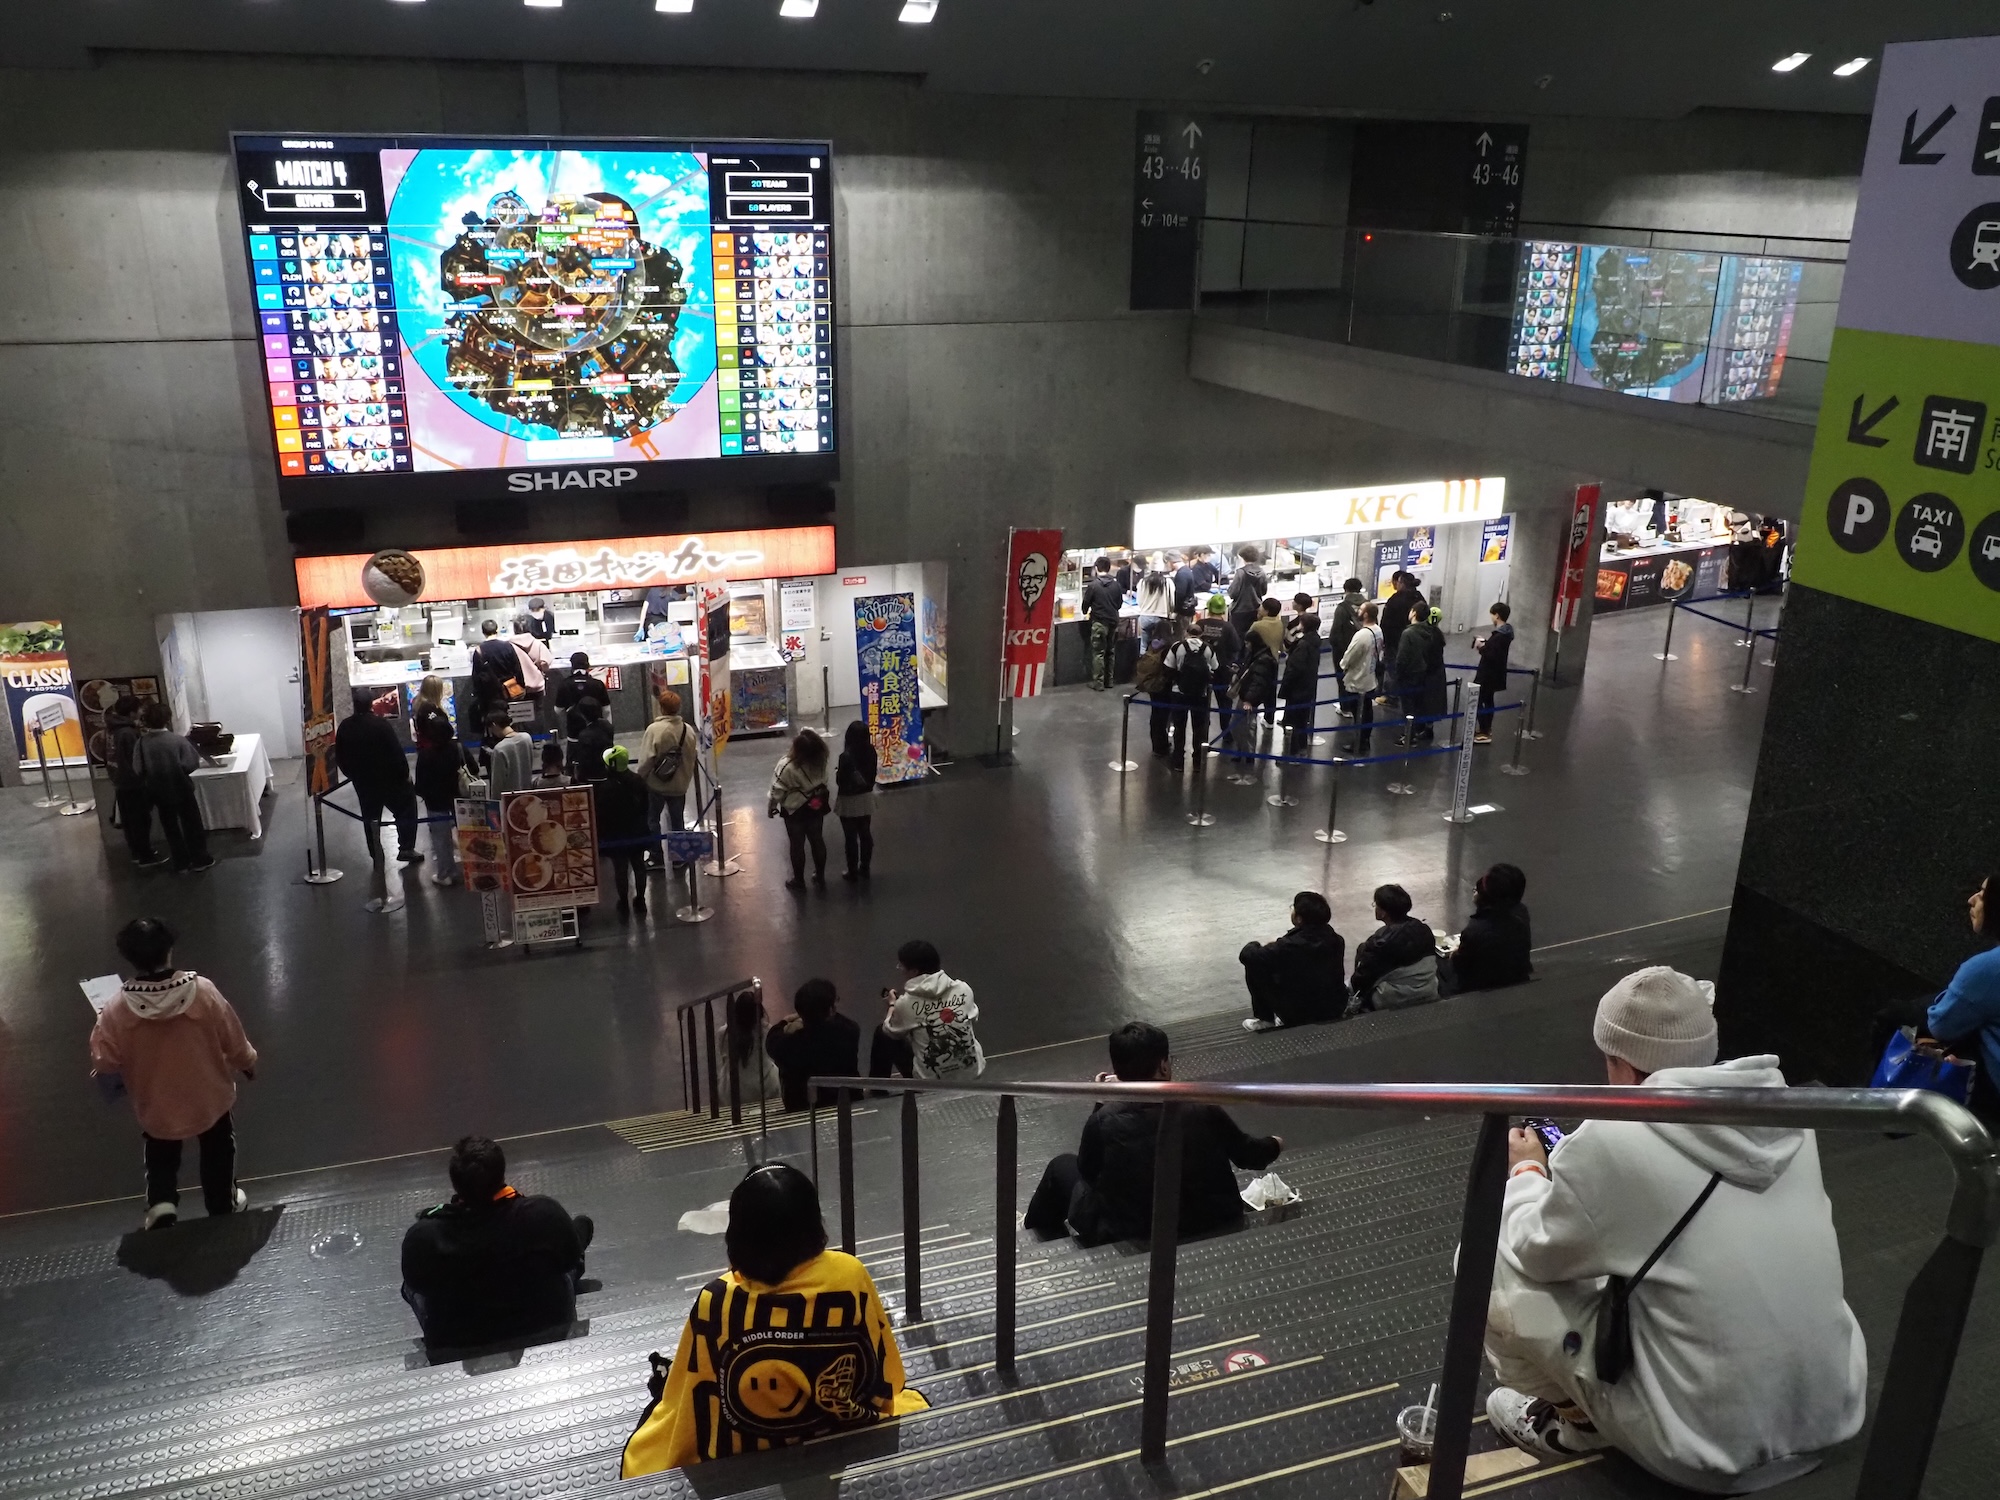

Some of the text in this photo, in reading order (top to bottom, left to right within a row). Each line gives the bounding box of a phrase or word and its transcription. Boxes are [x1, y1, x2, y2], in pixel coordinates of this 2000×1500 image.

[275, 160, 348, 186] MATCH 4
[751, 180, 788, 189] 20 TEAMS
[759, 203, 792, 212] PLAYERS
[818, 263, 823, 271] 7
[820, 328, 825, 337] 1
[1925, 408, 1975, 462] 南
[507, 467, 638, 493] SHARP
[1344, 492, 1418, 525] KFC
[1843, 493, 1875, 536] P
[1912, 503, 1954, 527] TAXI
[1381, 545, 1403, 555] ONLY
[1409, 538, 1432, 550] CLASSIC
[1565, 566, 1584, 583] FC
[785, 635, 801, 651] 氷
[1006, 628, 1047, 647] KFC
[880, 649, 901, 715] 新食感
[891, 716, 901, 746] アイス
[881, 727, 893, 768] クリーム
[912, 993, 967, 1016] Verhulst
[742, 1331, 773, 1344] RIDDLE
[774, 1331, 804, 1340] ORDER
